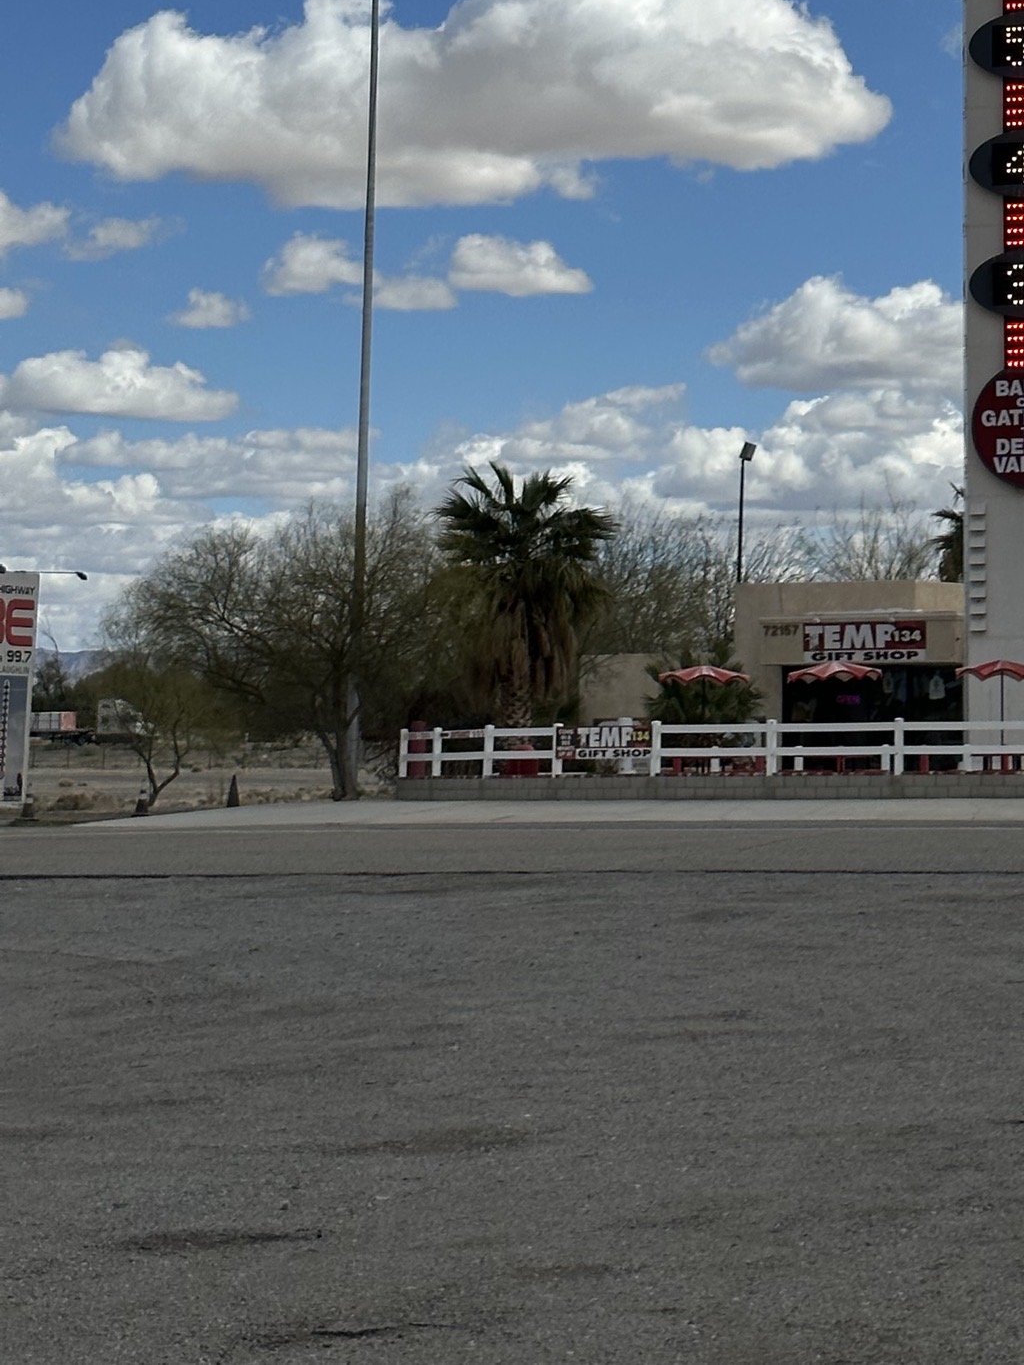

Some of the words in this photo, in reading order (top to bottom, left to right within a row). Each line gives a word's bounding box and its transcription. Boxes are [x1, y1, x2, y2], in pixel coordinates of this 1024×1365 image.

[804, 624, 896, 649] TEMP
[893, 630, 922, 642] 134
[7, 650, 32, 663] 99.7
[811, 651, 856, 662] GIFT
[863, 650, 920, 661] SHOP
[577, 727, 634, 747] TEMP
[632, 730, 650, 741] 134
[578, 749, 608, 758] GIFT
[612, 749, 652, 757] SHOP
